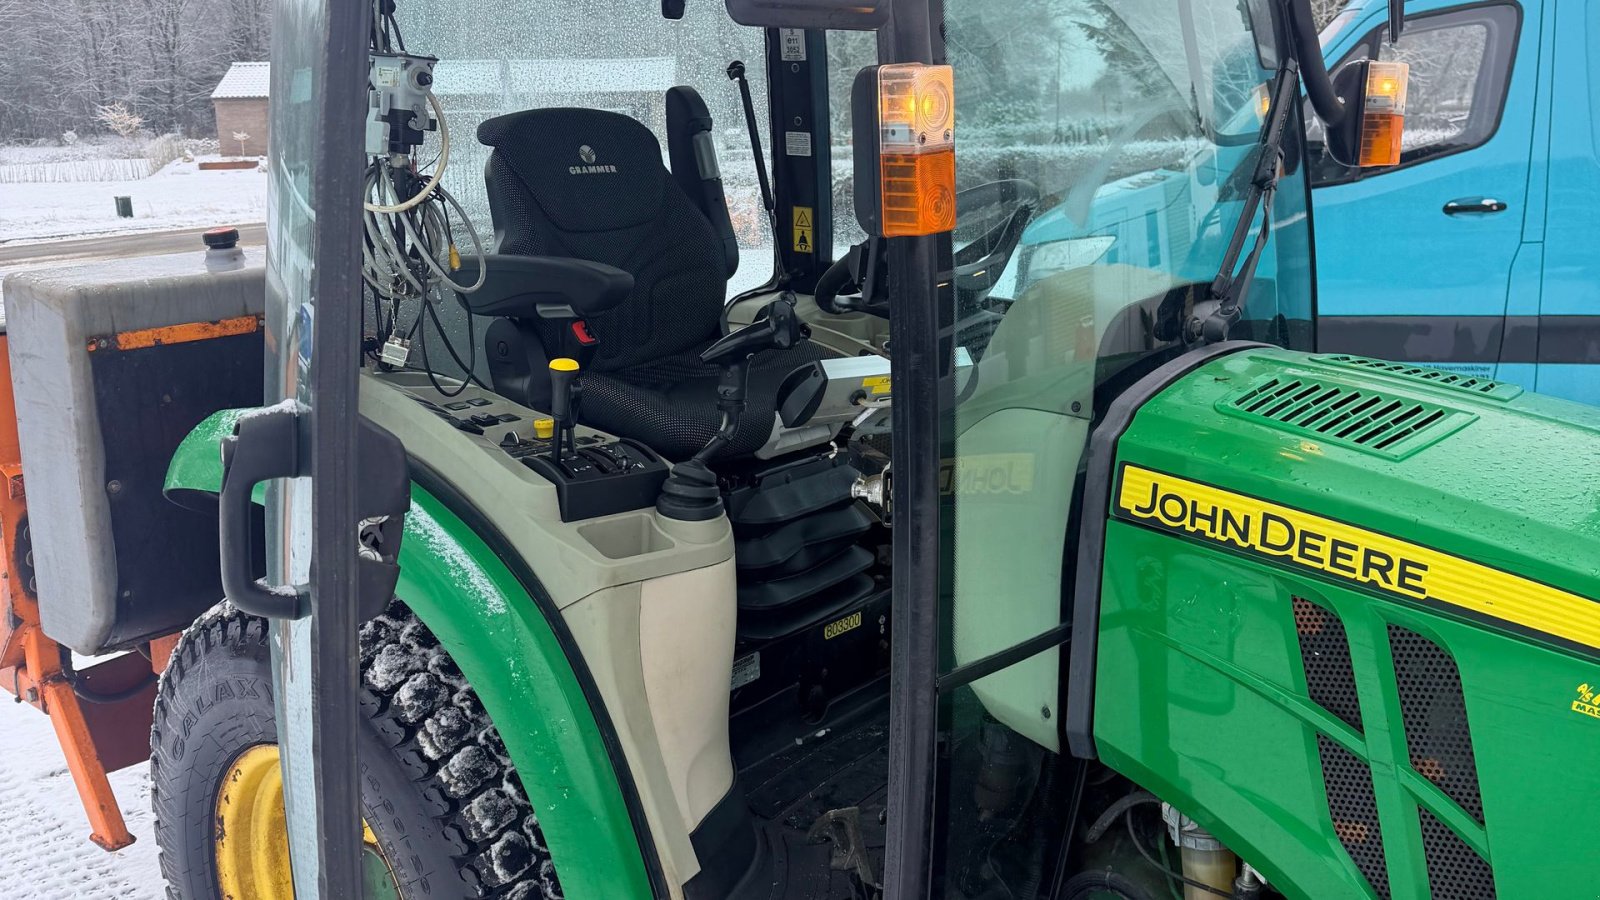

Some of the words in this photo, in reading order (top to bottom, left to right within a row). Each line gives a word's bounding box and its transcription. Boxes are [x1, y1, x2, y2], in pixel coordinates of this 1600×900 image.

[569, 165, 617, 175] GRAMMER
[1134, 482, 1251, 544] JOHN
[1259, 511, 1430, 596] DEERE
[826, 613, 861, 638] 803300
